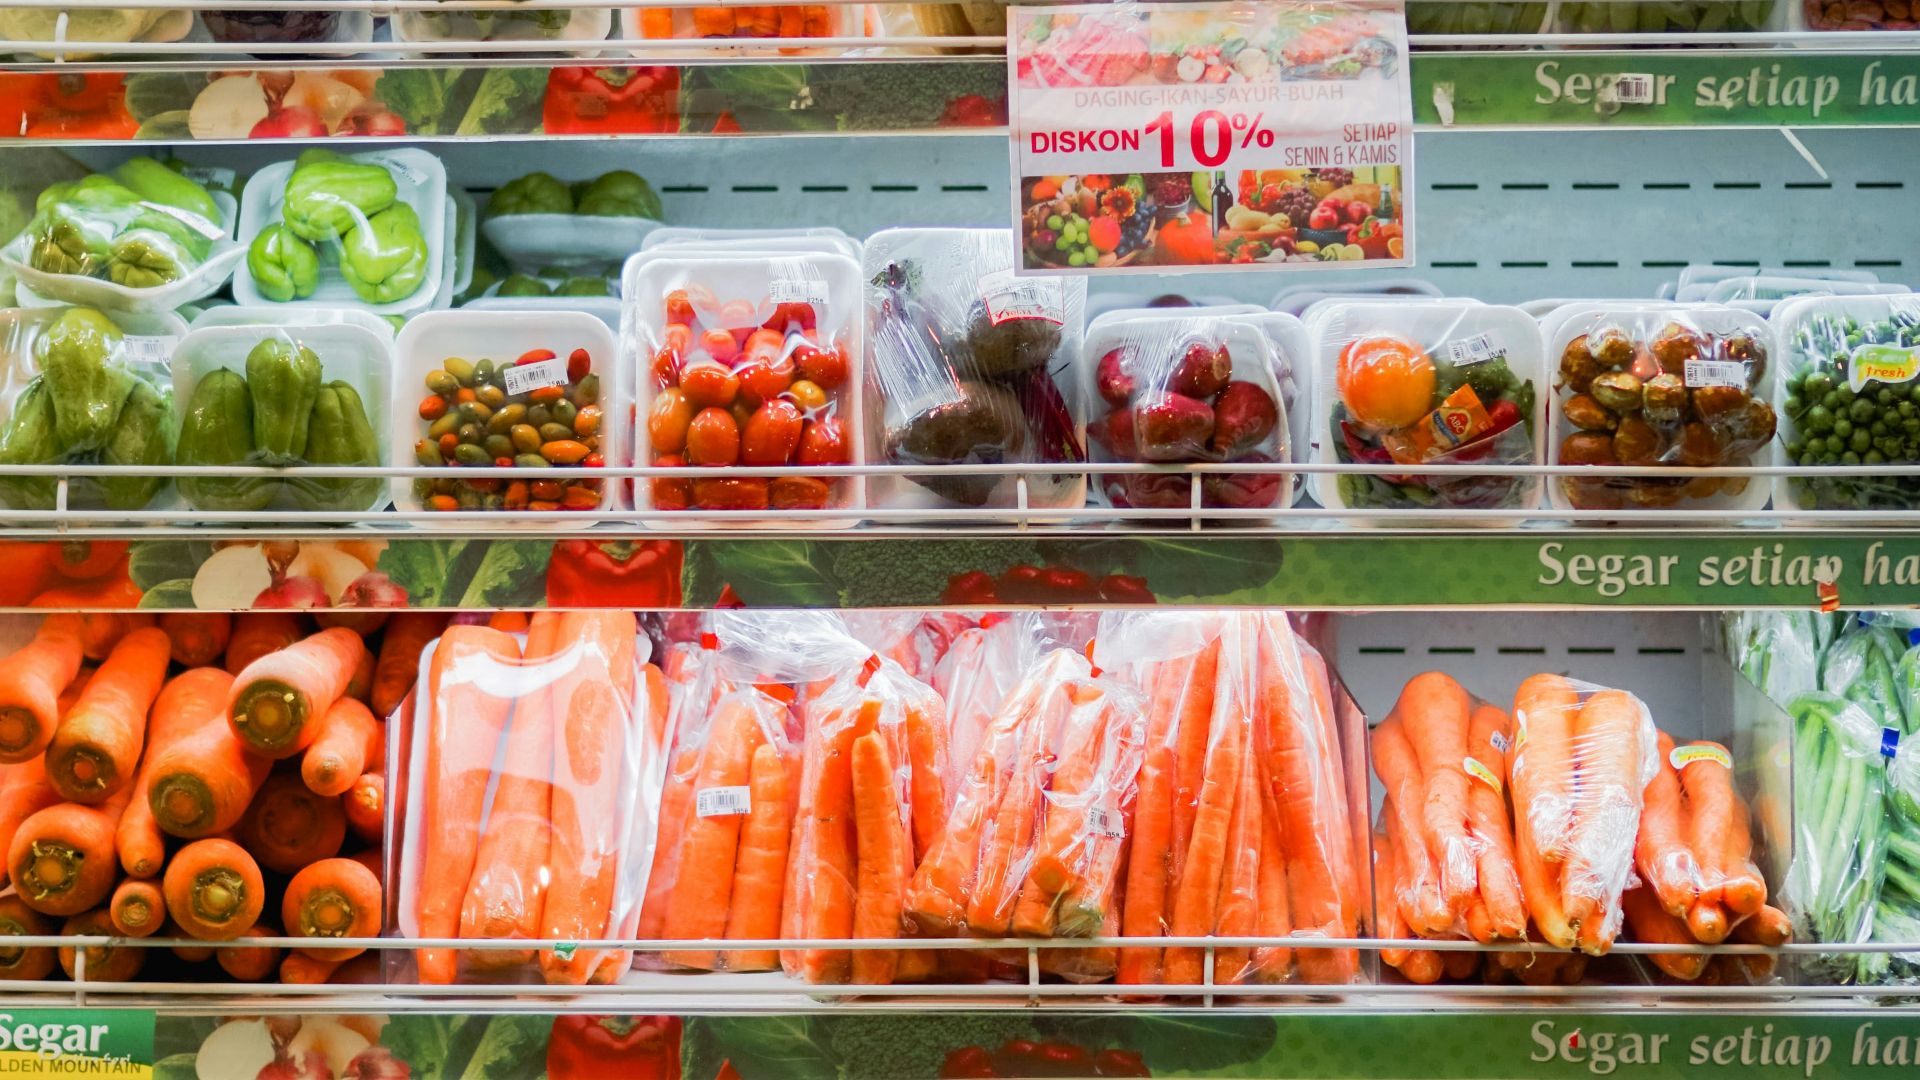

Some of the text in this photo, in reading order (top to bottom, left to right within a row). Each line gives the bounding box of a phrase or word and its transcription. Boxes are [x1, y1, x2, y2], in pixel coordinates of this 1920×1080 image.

[1074, 85, 1344, 108] DAGING-IKAN-SAYUR-BUAH
[1535, 61, 1676, 115] Segr
[1694, 64, 1840, 117] setiap
[1030, 109, 1275, 168] DISKON 10%
[1343, 122, 1397, 143] SETIAP
[1284, 144, 1397, 167] SENIN & KAMIS
[1866, 366, 1907, 378] fresh
[1447, 414, 1465, 433] ABC
[1537, 542, 1680, 597] Segar
[1698, 543, 1843, 598] setiap
[0, 1013, 109, 1061] Segar
[1530, 1019, 1920, 1078] Segar setiap ha
[50, 1059, 141, 1073] MOUNTAIN
